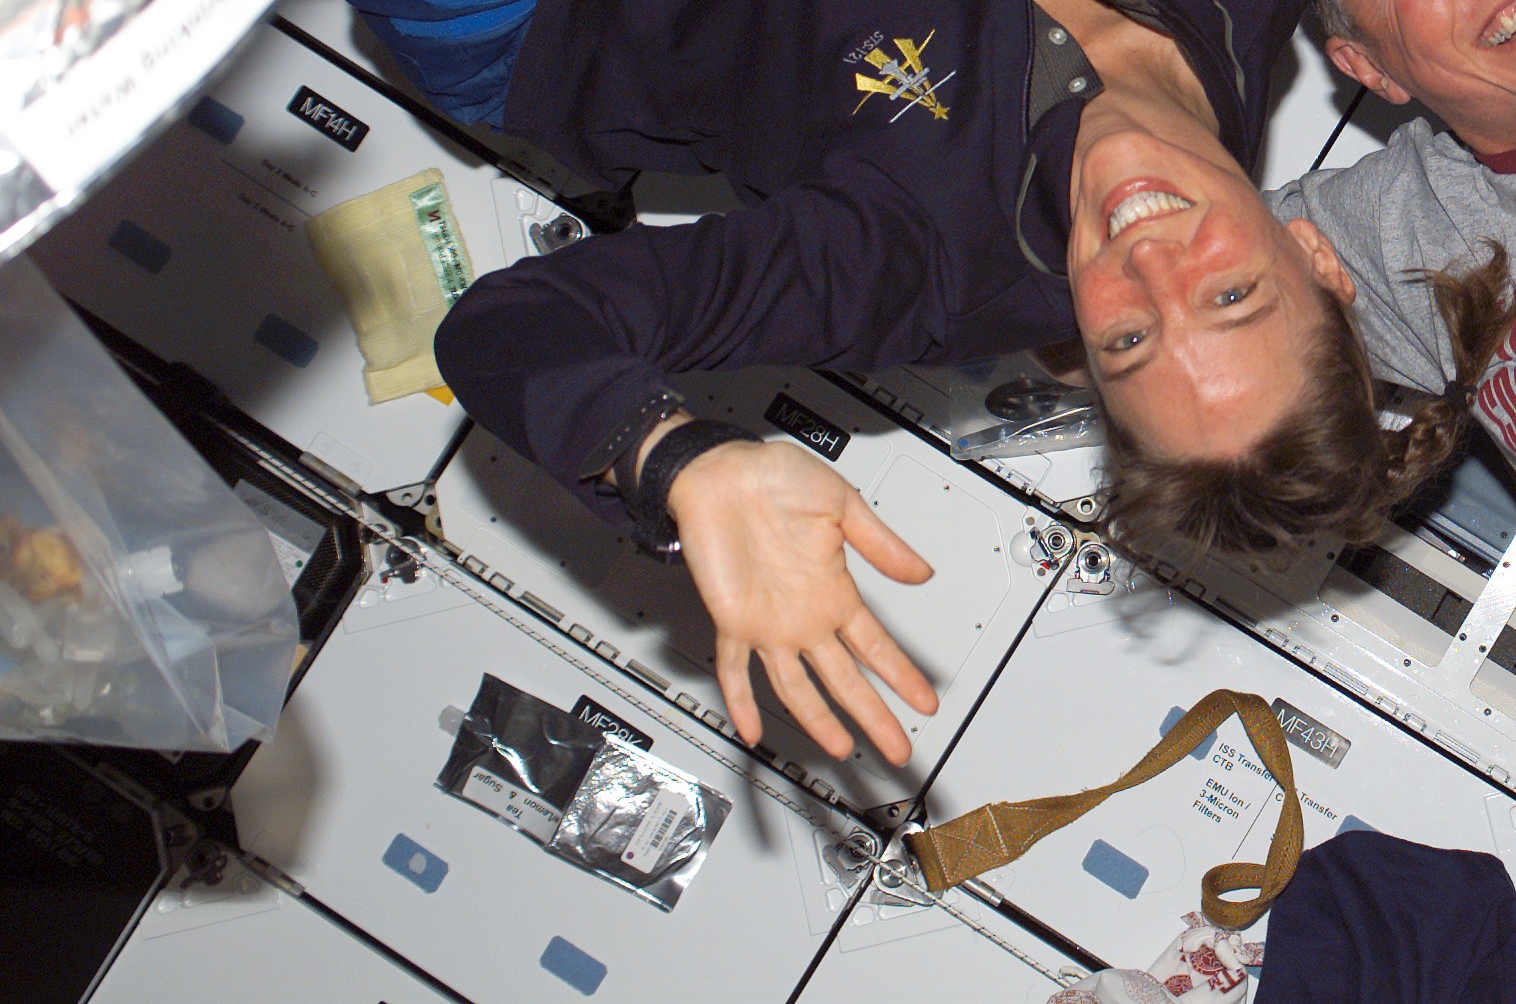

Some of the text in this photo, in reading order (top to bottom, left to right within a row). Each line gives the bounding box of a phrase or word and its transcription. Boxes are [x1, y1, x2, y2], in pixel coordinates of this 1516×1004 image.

[300, 96, 357, 141] MF14H
[1277, 708, 1339, 758] MF43H
[1212, 754, 1234, 772] CTB
[1218, 743, 1275, 783] ISS Transfer
[473, 772, 503, 795] Sugar
[508, 790, 517, 801] &
[1206, 778, 1229, 796] EMU
[506, 804, 524, 820] Tea
[1192, 799, 1222, 823] Filters
[1199, 789, 1240, 819] 3-Micron
[1300, 792, 1338, 820] Transfer
